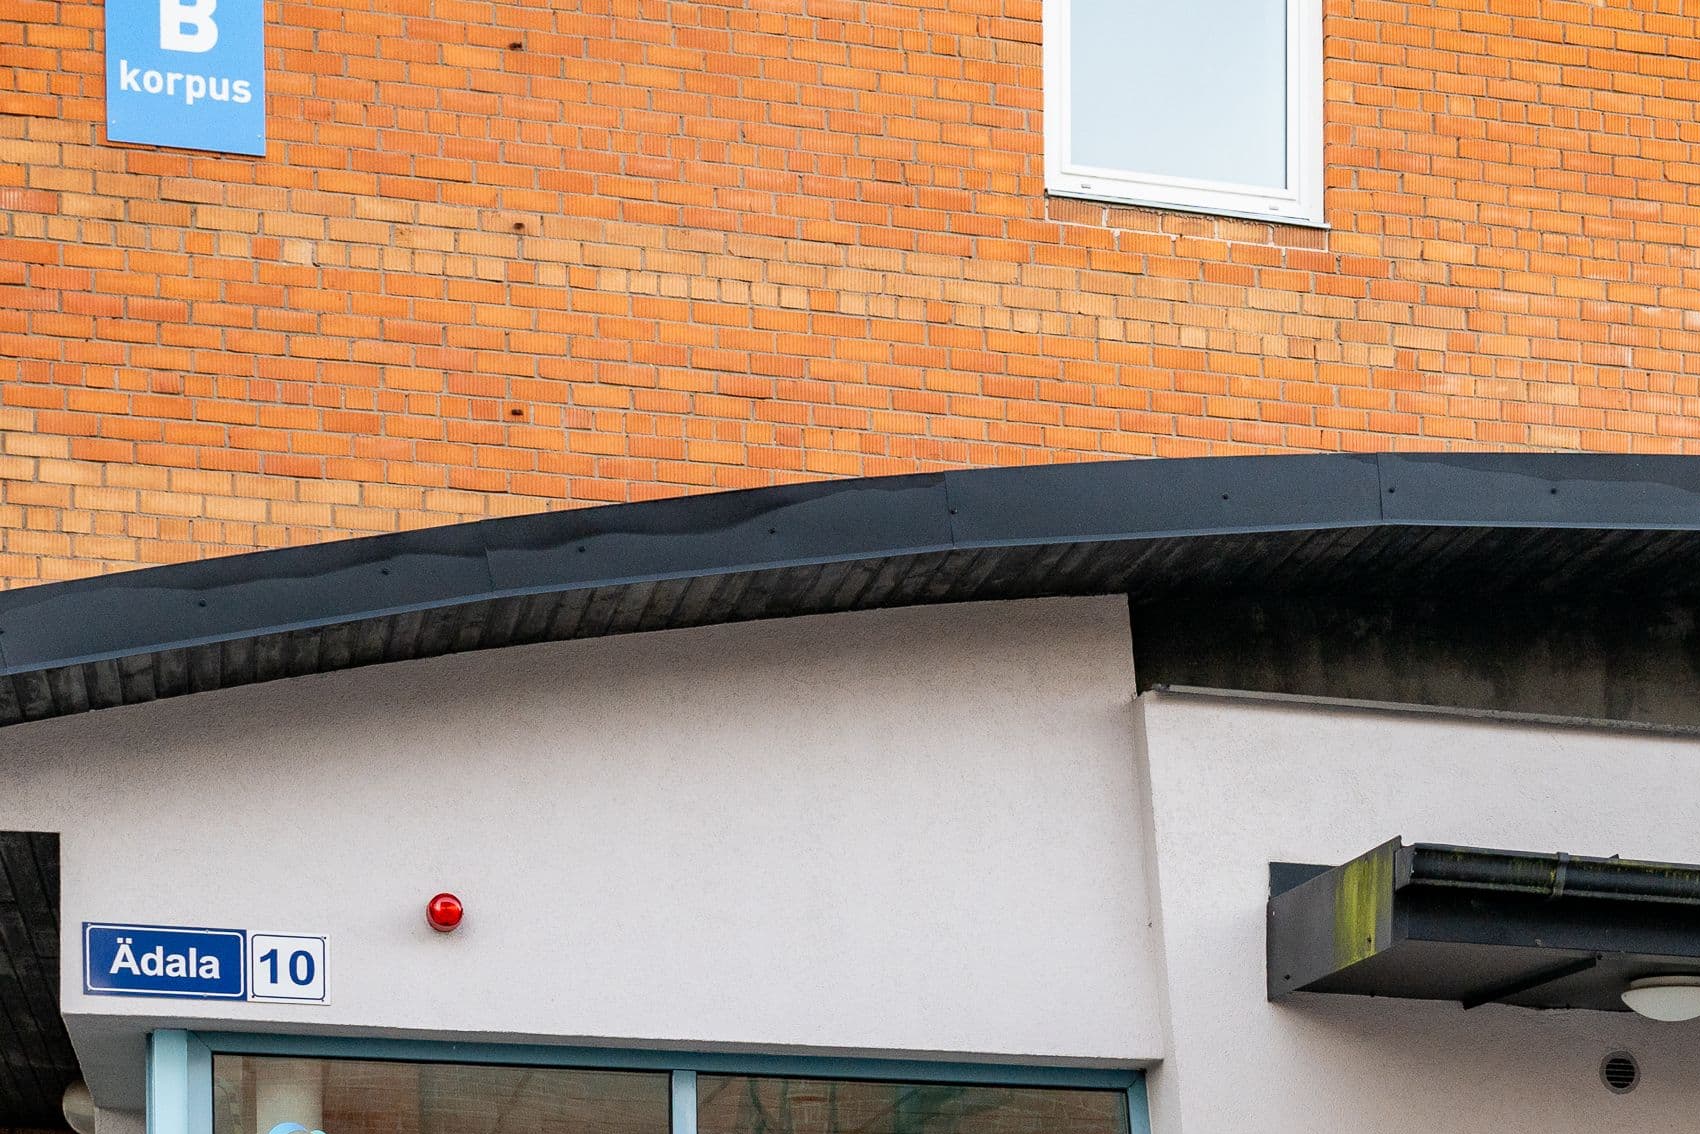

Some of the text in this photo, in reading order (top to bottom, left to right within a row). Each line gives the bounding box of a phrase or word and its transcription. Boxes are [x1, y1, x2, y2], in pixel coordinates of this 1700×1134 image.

[159, 0, 218, 53] B
[119, 59, 252, 105] korpus
[109, 937, 221, 980] Ädala
[259, 948, 316, 986] 10
